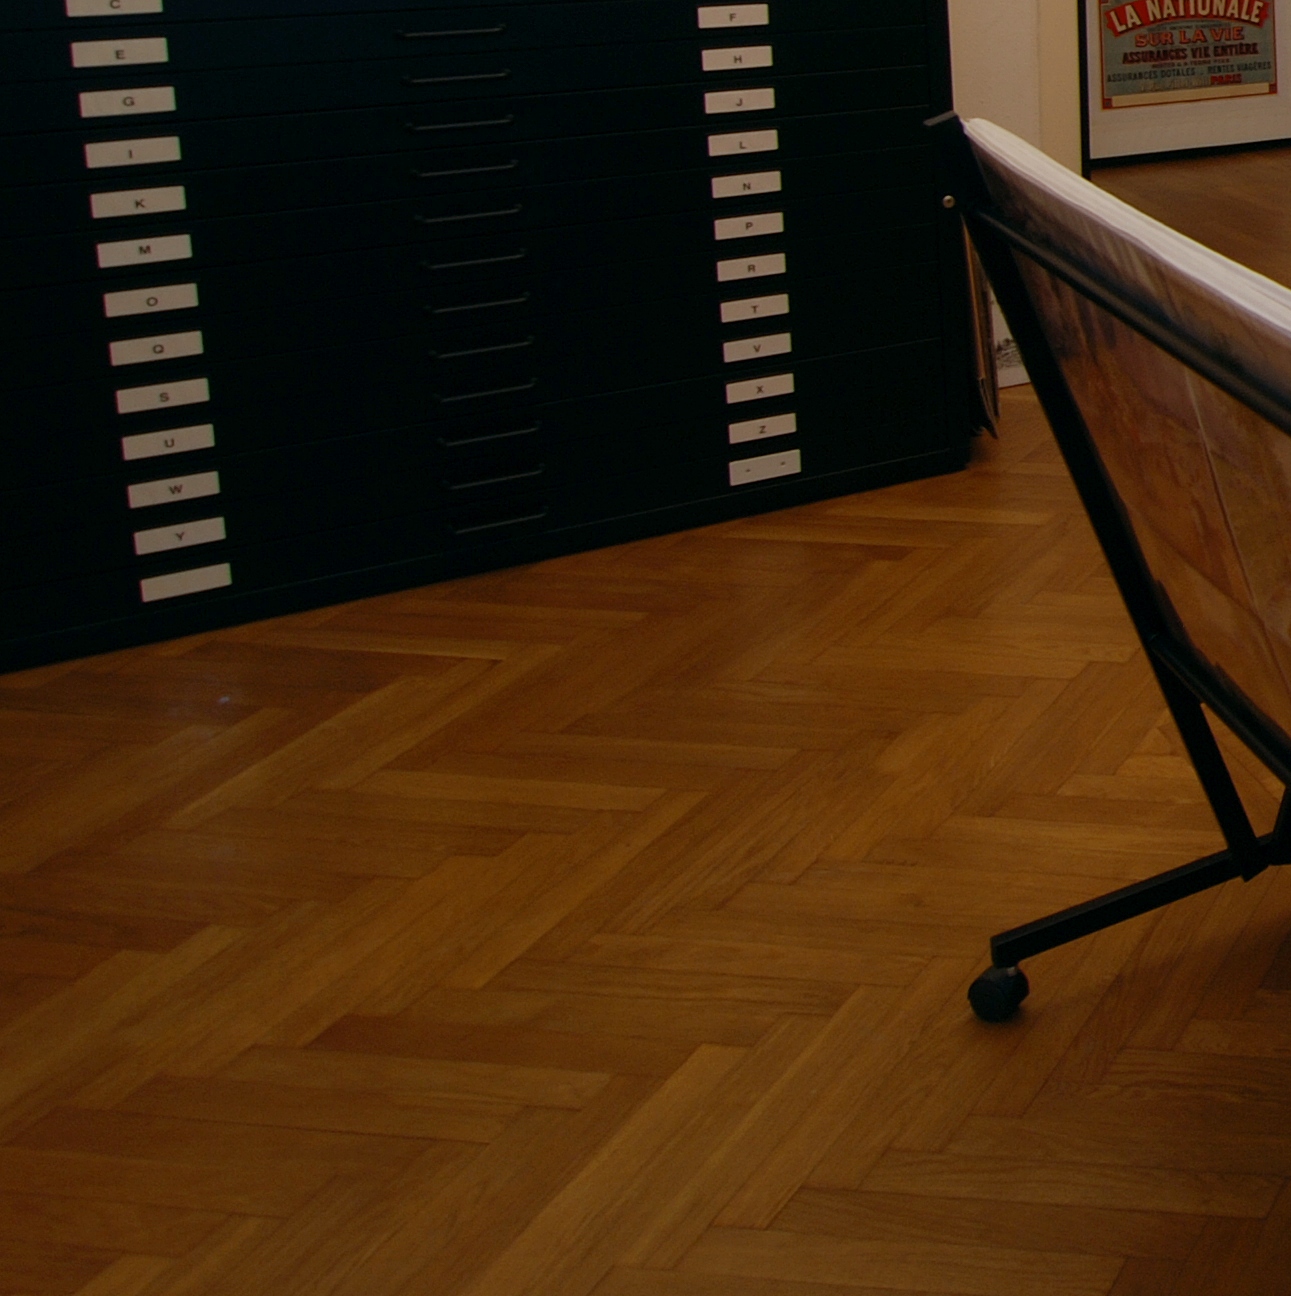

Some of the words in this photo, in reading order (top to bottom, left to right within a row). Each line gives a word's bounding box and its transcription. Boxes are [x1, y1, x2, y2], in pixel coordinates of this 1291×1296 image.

[1110, 4, 1142, 33] LA
[1135, 31, 1173, 47] SUR
[1180, 28, 1207, 44] LA
[1211, 26, 1244, 41] VIE
